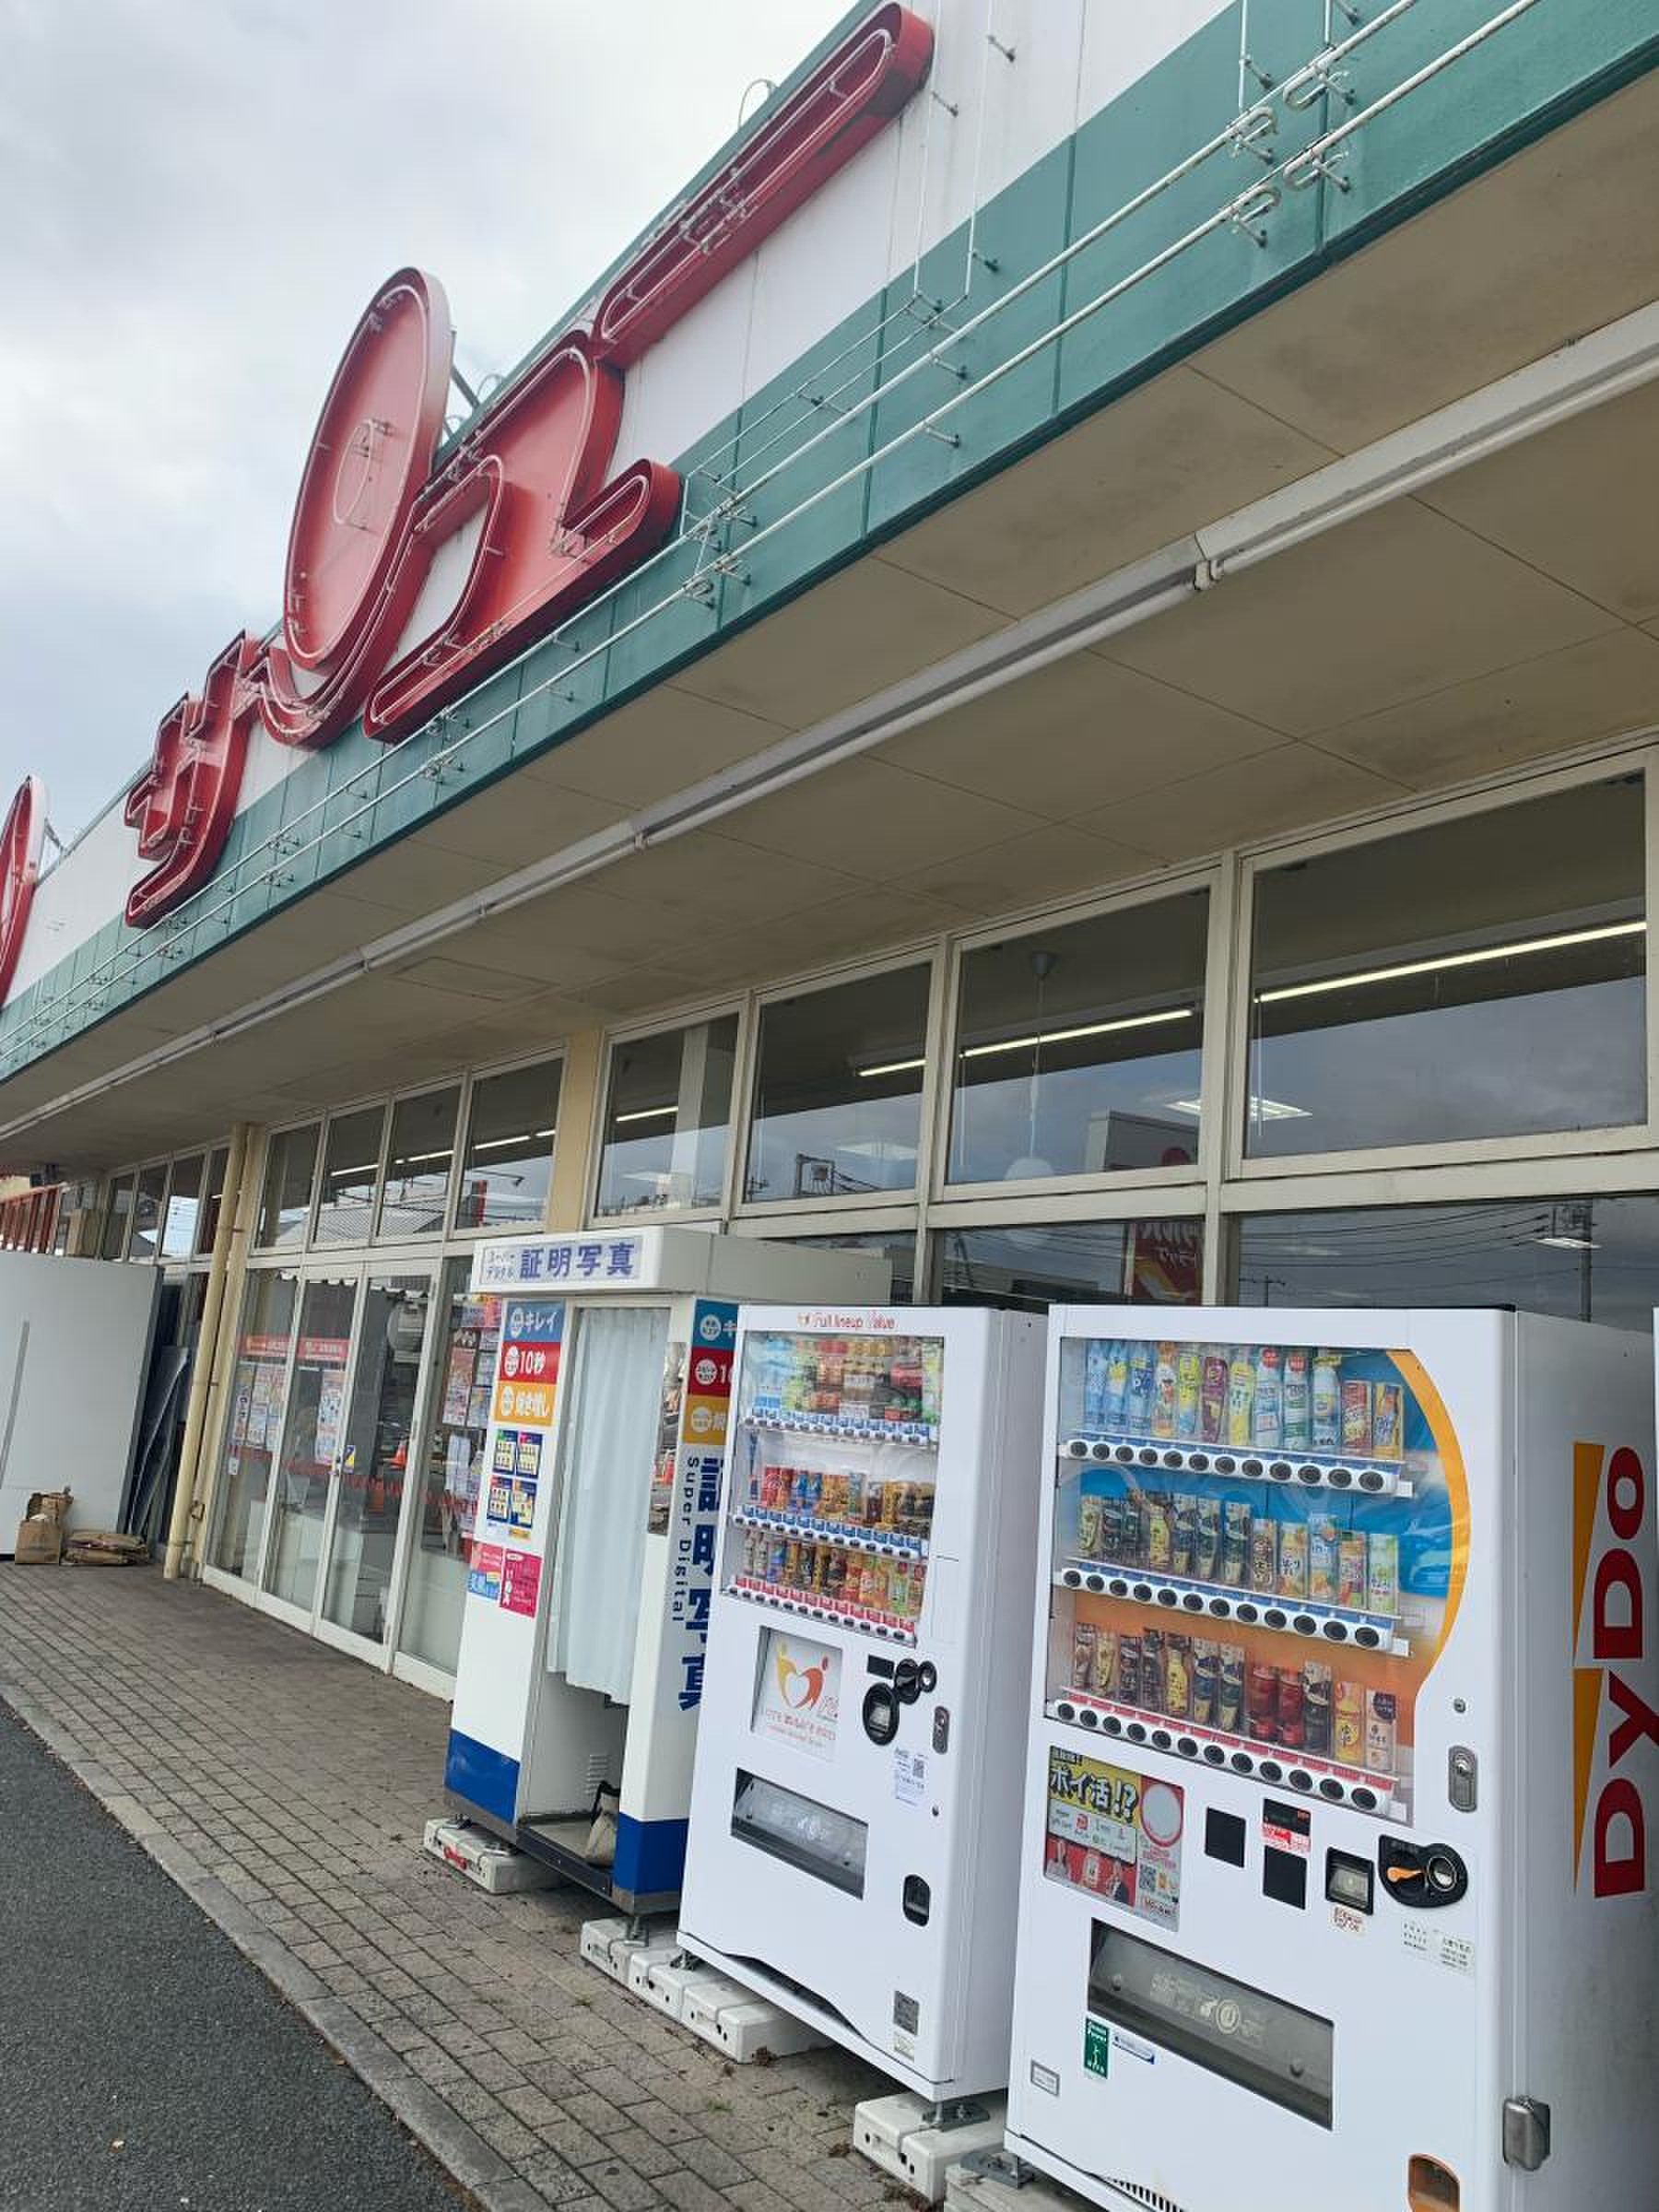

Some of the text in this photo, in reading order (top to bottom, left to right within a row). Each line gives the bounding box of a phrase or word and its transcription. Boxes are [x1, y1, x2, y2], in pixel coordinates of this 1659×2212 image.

[520, 1242, 634, 1279] 証明写真
[525, 1312, 558, 1334] キレイ
[520, 1349, 547, 1375] 10秒
[673, 1457, 699, 1621] Super Digital
